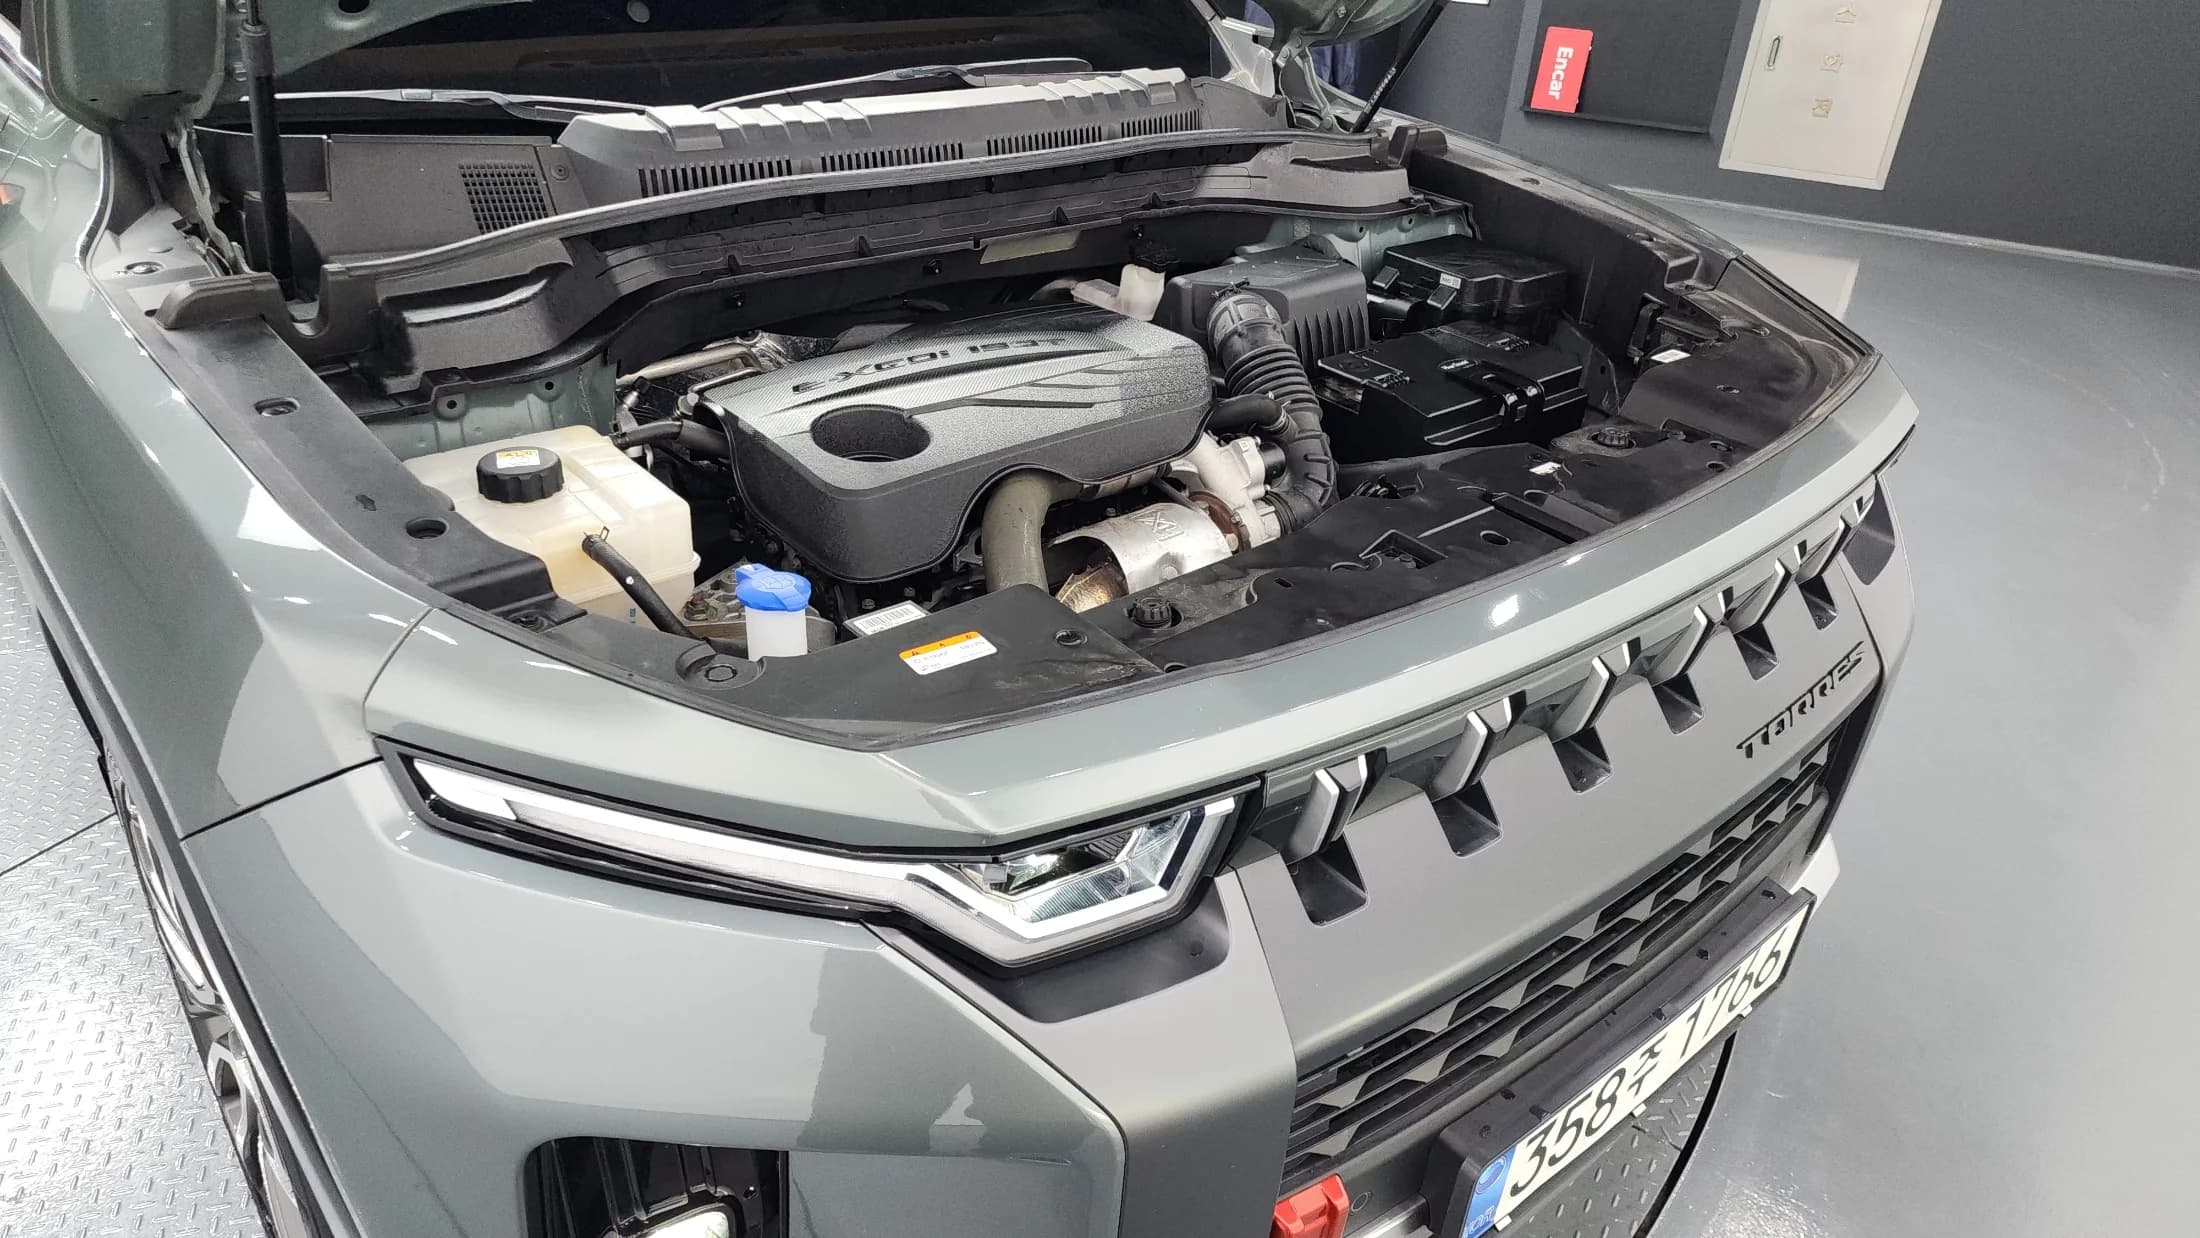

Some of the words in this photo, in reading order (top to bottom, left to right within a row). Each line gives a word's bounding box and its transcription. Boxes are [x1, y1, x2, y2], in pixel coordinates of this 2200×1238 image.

[1547, 46, 1575, 101] Encar
[1736, 640, 1865, 759] TORRES
[1510, 1030, 1668, 1198] 358주
[1680, 925, 1789, 1060] 1766
